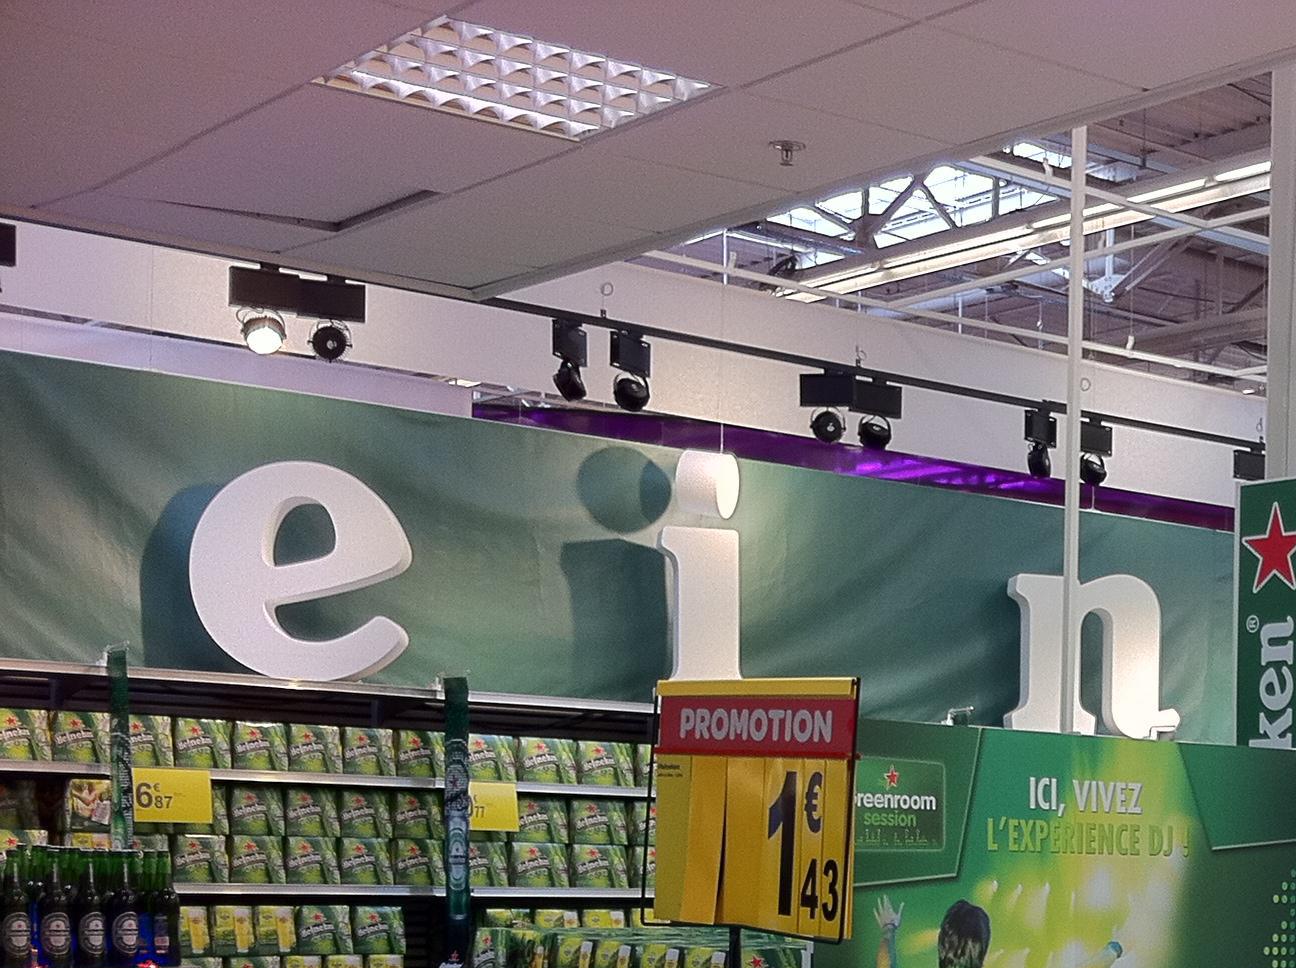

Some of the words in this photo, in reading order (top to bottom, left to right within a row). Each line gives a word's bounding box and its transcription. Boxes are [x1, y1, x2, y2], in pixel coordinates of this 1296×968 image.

[679, 707, 832, 743] PROMOTION
[852, 791, 937, 811] reenroom
[1029, 776, 1066, 817] ICI,
[1072, 779, 1144, 815] VIVEZ
[864, 811, 917, 827] session
[1148, 825, 1174, 857] DJ
